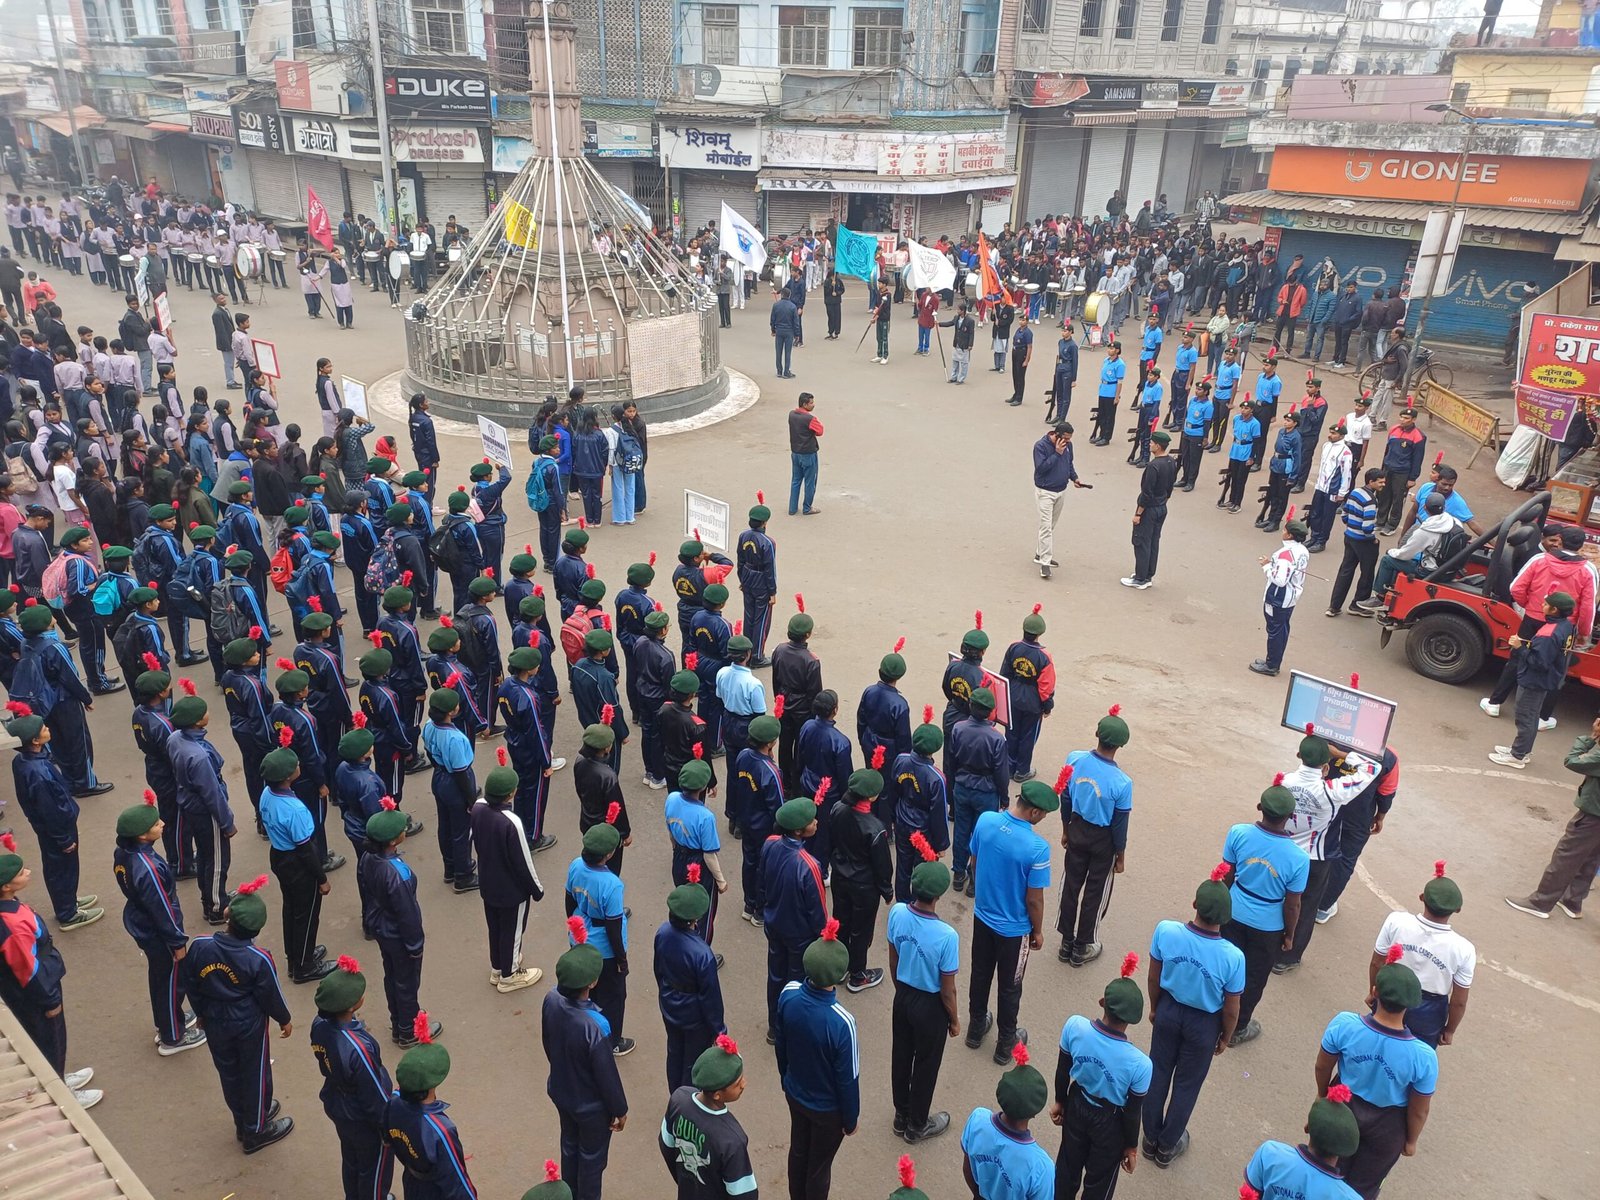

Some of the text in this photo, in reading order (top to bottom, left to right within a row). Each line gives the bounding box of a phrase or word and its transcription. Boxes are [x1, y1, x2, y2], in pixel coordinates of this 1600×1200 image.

[1104, 87, 1137, 100] SAMSUNG
[195, 117, 236, 138] ANUPAM
[267, 115, 280, 149] SONY
[408, 148, 465, 160] DRESSES
[1380, 157, 1500, 184] GIONEE
[1508, 196, 1576, 207] AGRAWAL TRADERS
[1303, 213, 1415, 238] अग्रवाल
[676, 1114, 706, 1155] BULLS
